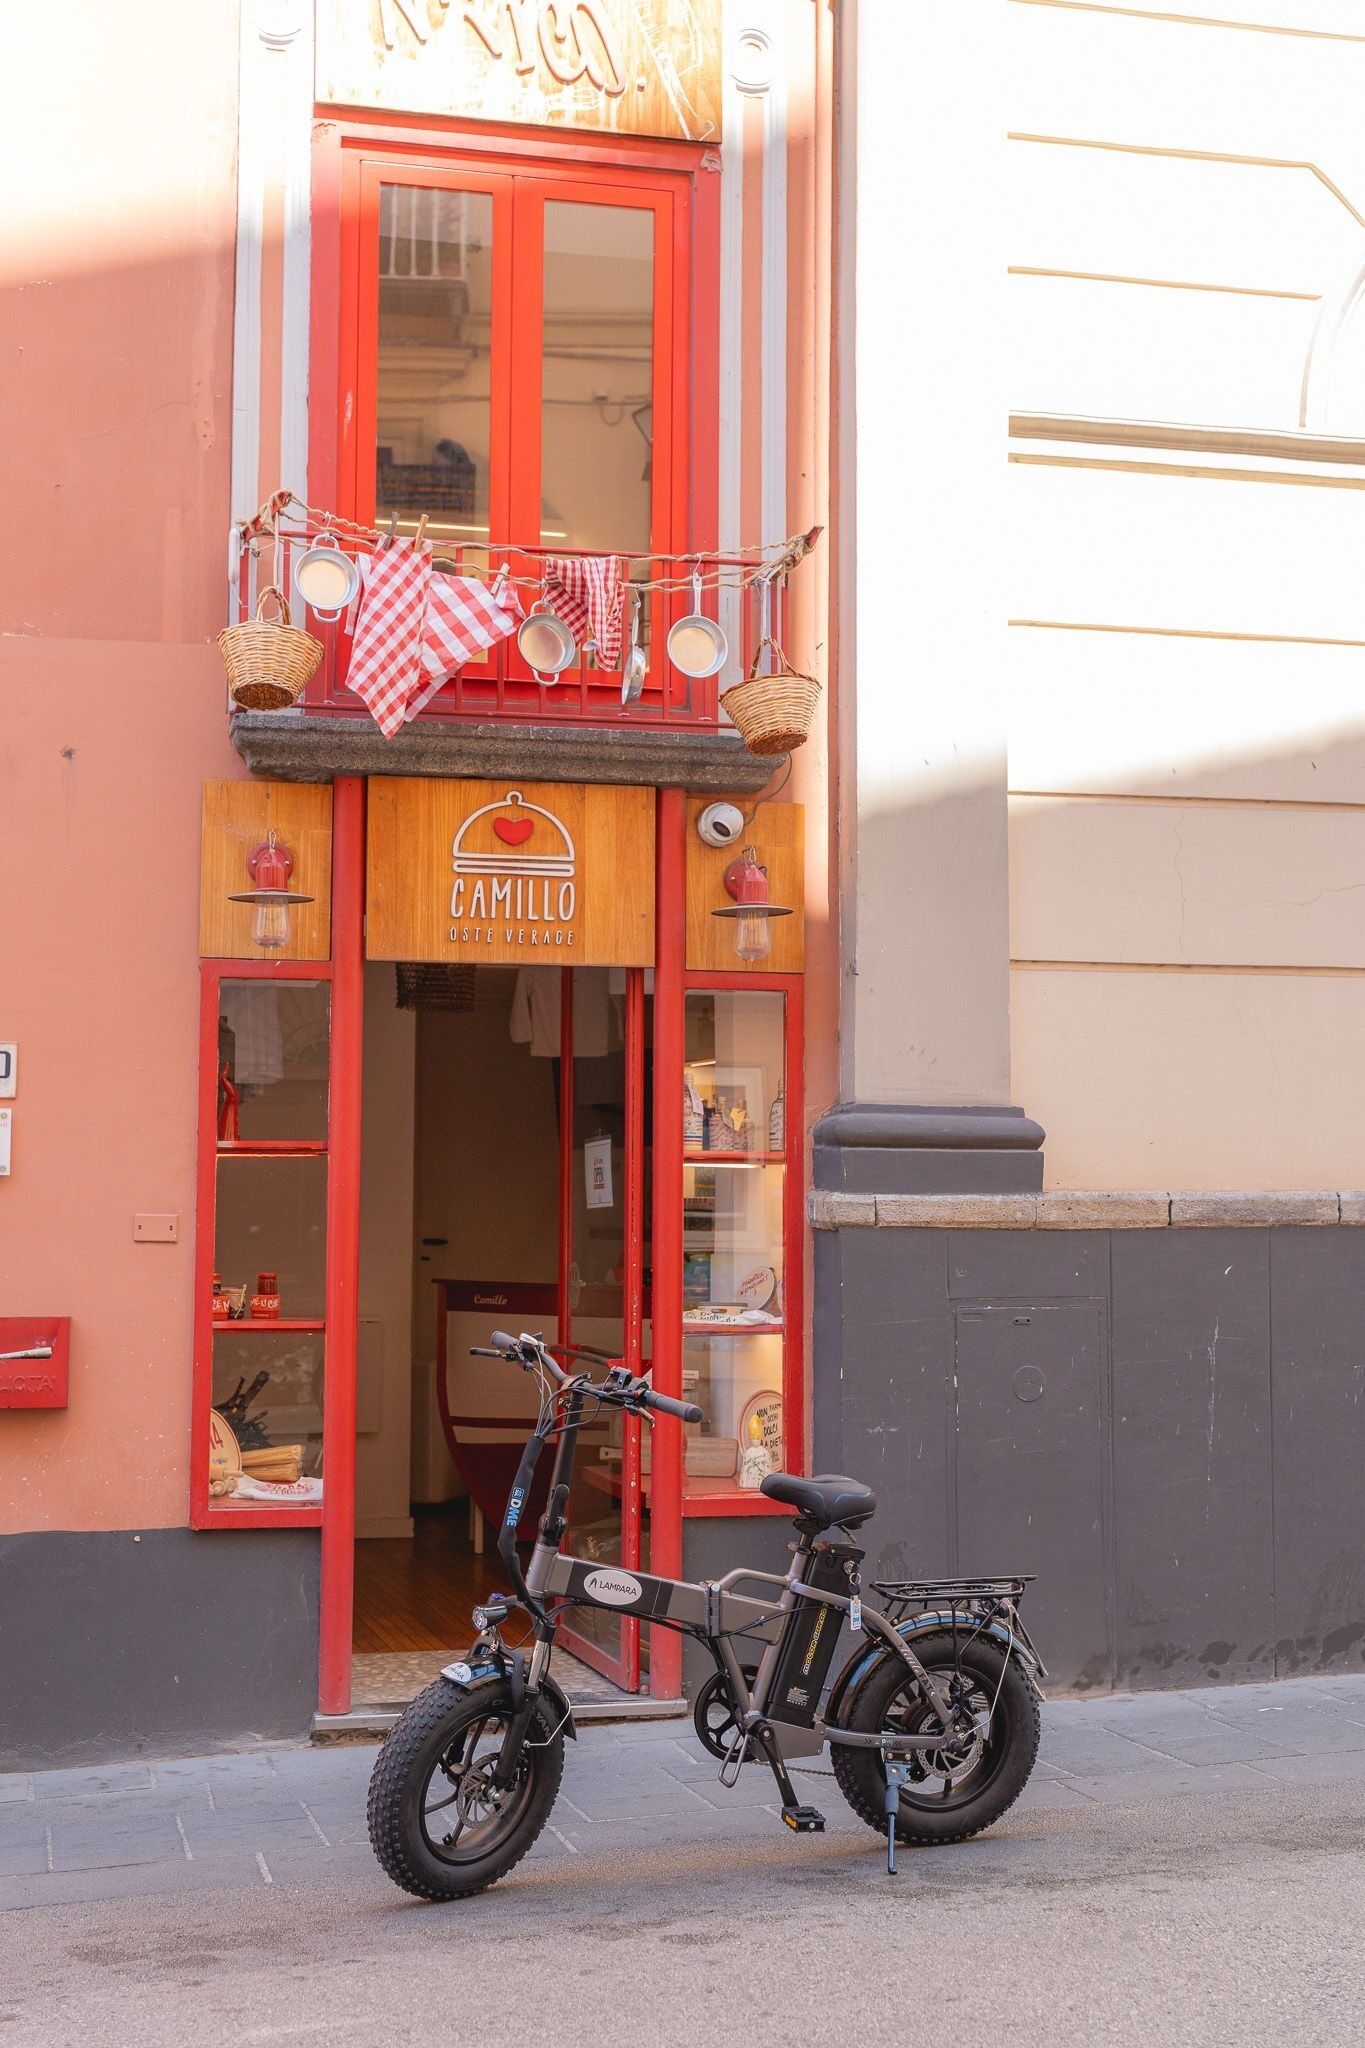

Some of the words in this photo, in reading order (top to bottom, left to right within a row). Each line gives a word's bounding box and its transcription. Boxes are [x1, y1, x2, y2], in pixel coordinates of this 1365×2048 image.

[450, 876, 575, 922] CAMILLO
[450, 926, 494, 944] OSTE
[474, 1294, 508, 1306] Camillo
[506, 1498, 522, 1527] DME
[599, 1580, 637, 1596] LAMPARA
[919, 1672, 935, 1691] FAT
